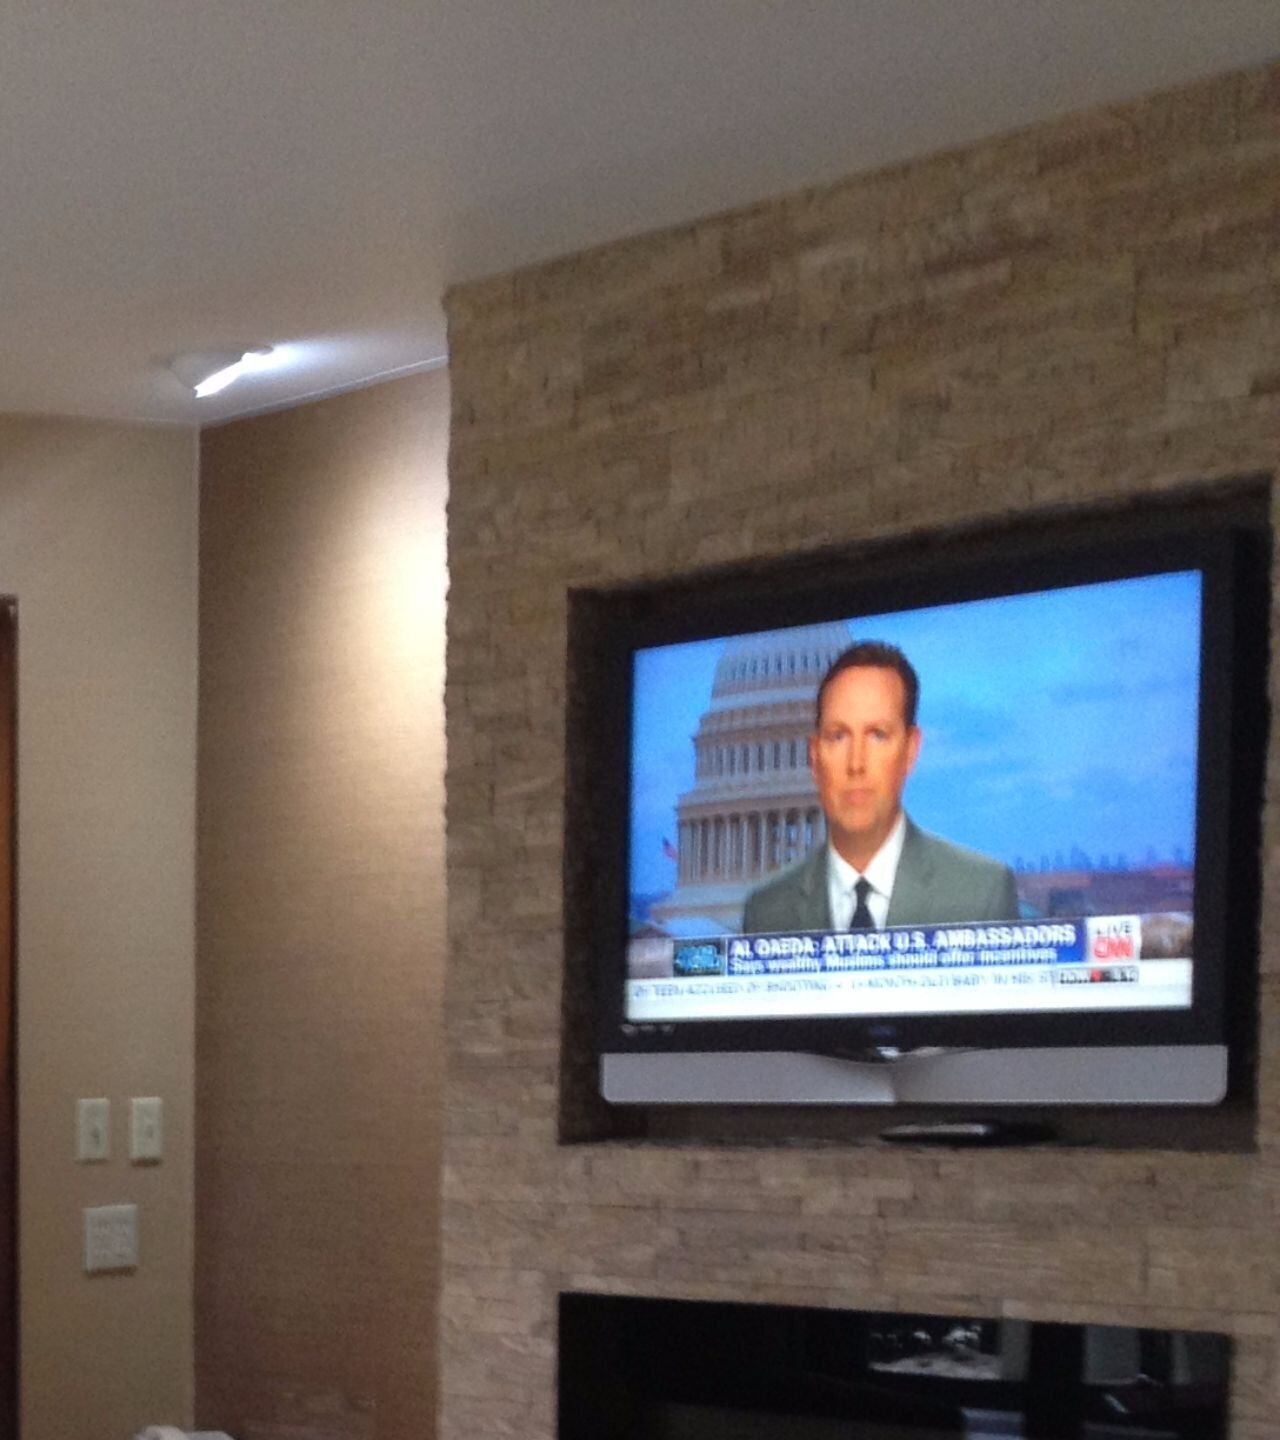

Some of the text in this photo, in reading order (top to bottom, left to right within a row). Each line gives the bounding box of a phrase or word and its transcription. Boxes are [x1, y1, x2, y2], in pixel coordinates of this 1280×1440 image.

[821, 933, 890, 954] ATTACK
[893, 931, 930, 951] U.S.
[933, 924, 1076, 949] AMBASSADORS
[1096, 921, 1132, 935] LIVE
[1094, 936, 1134, 958] CNN
